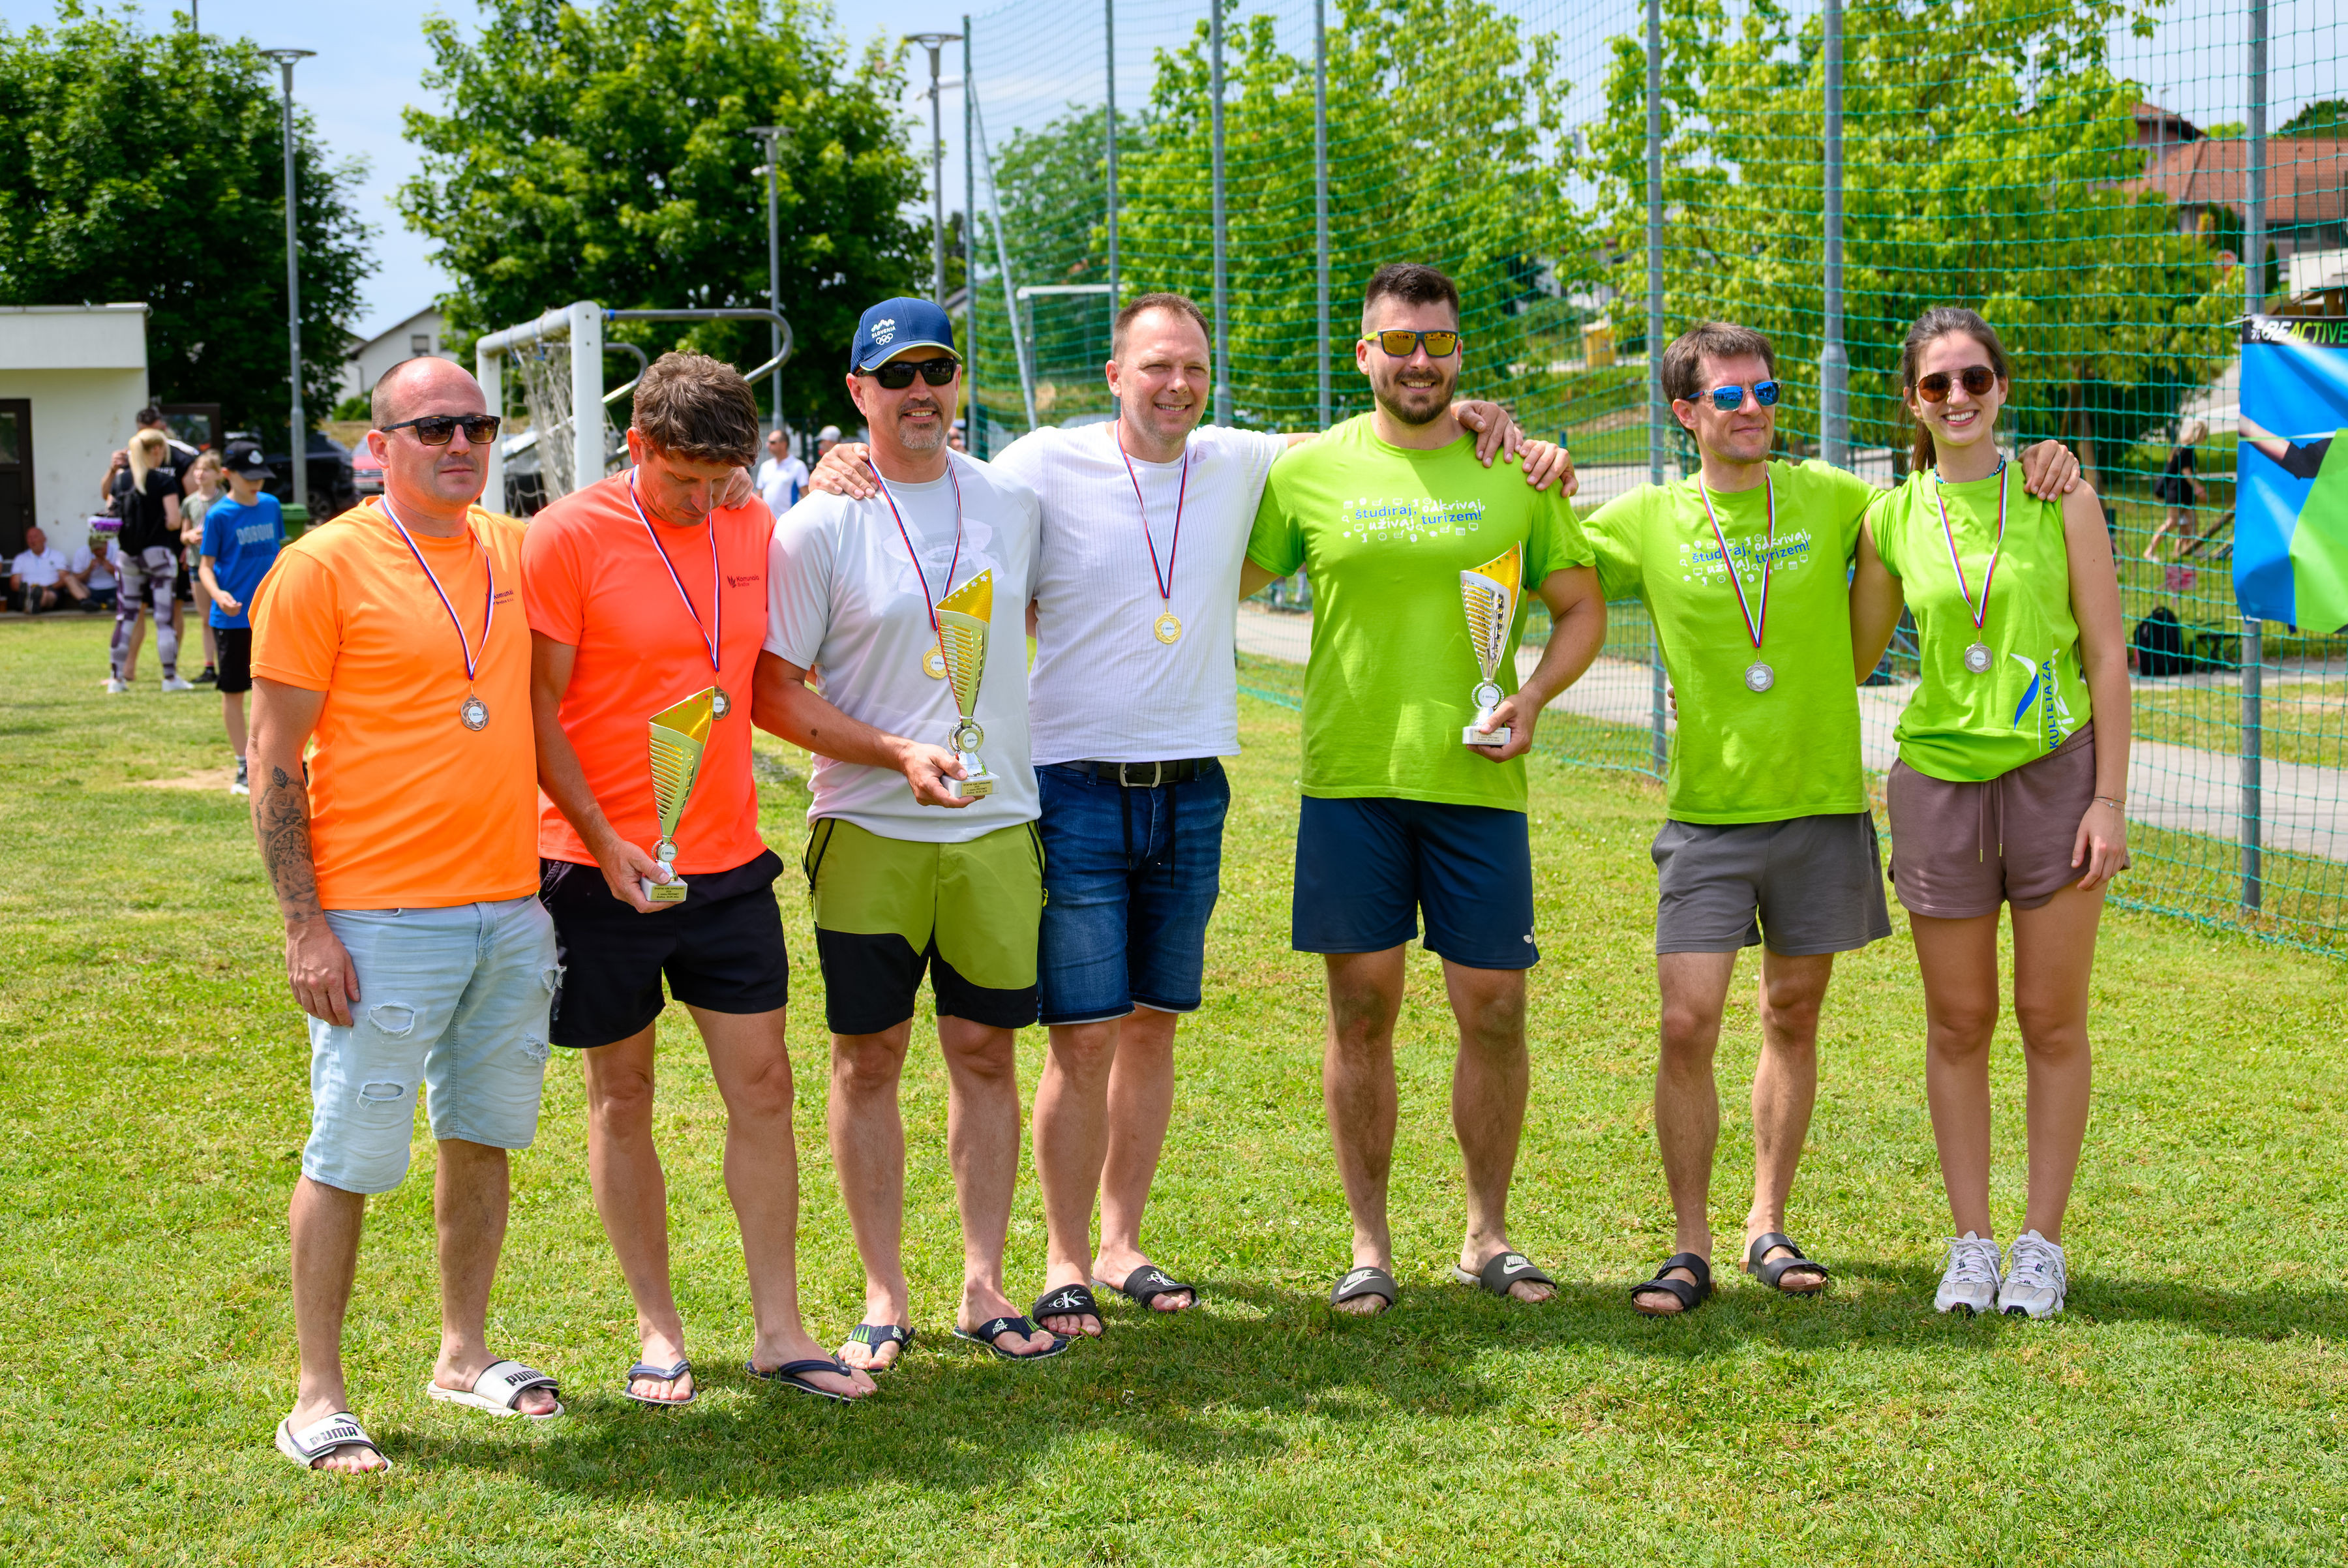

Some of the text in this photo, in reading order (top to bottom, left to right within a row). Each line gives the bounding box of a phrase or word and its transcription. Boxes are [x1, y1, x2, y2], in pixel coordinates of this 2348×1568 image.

[871, 325, 896, 339] SLOVENIA
[1355, 498, 1485, 519] študiraj, odkrivaj,
[1421, 510, 1482, 524] turizem!
[1692, 543, 1751, 563] študraj,
[1755, 539, 1810, 564] turizem!
[2042, 661, 2051, 682] ZA
[1505, 1255, 1529, 1266] NIKE
[1344, 1269, 1373, 1287] NIKE
[992, 1324, 1009, 1334] PEAK
[310, 1426, 359, 1446] PUMA
